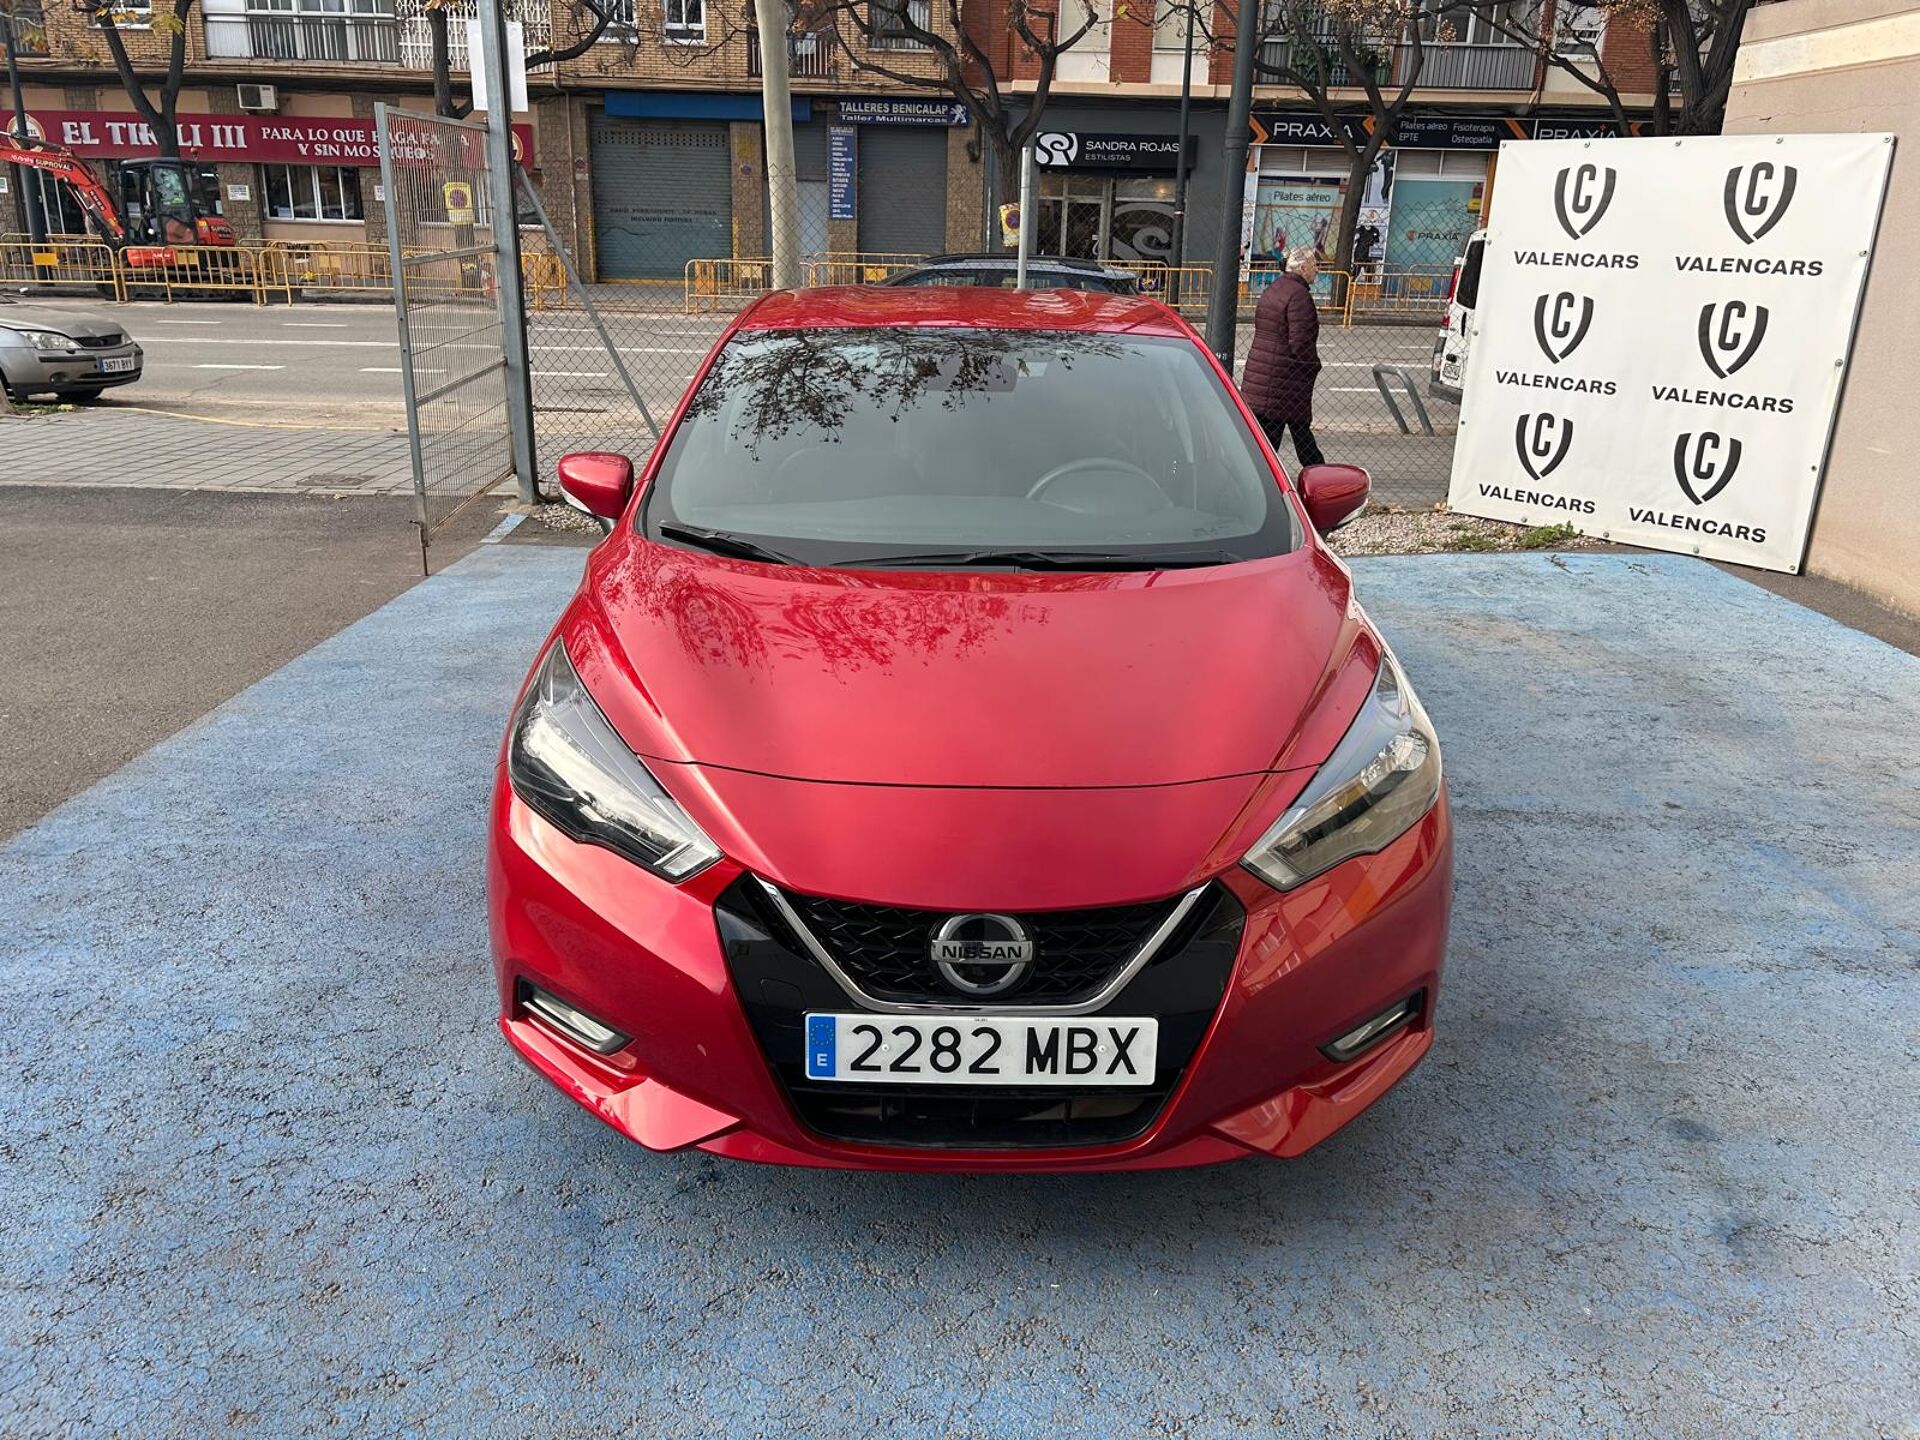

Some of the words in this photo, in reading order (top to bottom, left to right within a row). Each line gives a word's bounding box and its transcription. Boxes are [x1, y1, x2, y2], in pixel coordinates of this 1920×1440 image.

[840, 102, 889, 114] TALLERES
[892, 103, 948, 115] BENICALAP
[876, 115, 948, 123] Multimarcas
[1400, 120, 1425, 131] Pilates
[62, 121, 99, 145] EL
[105, 121, 203, 148] TIRLI
[211, 125, 248, 148] III
[261, 127, 304, 140] PARA
[307, 128, 328, 141] LO
[332, 129, 365, 142] QUE
[1273, 121, 1354, 139] PRAXA
[1452, 122, 1495, 133] Fisioterapia
[1399, 132, 1419, 141] EPTE
[298, 143, 309, 155] Y
[314, 144, 340, 156] SIN
[1085, 140, 1137, 151] SANDRA
[1139, 142, 1180, 153] ROJAS
[1085, 153, 1132, 161] ESTILISTAS
[1273, 190, 1303, 201] Pilates
[1514, 251, 1639, 269] VALENCARS
[1675, 256, 1823, 277] VALENCARS
[1496, 370, 1617, 396] VALENCARS
[1652, 385, 1794, 414] VALENCARS
[1478, 483, 1596, 515] VALENCARS
[1628, 507, 1767, 544] VALENCARS
[942, 945, 1023, 960] NISSAN
[849, 1024, 1002, 1075] 2282
[1025, 1026, 1140, 1075] MBX
[816, 1053, 828, 1067] E
